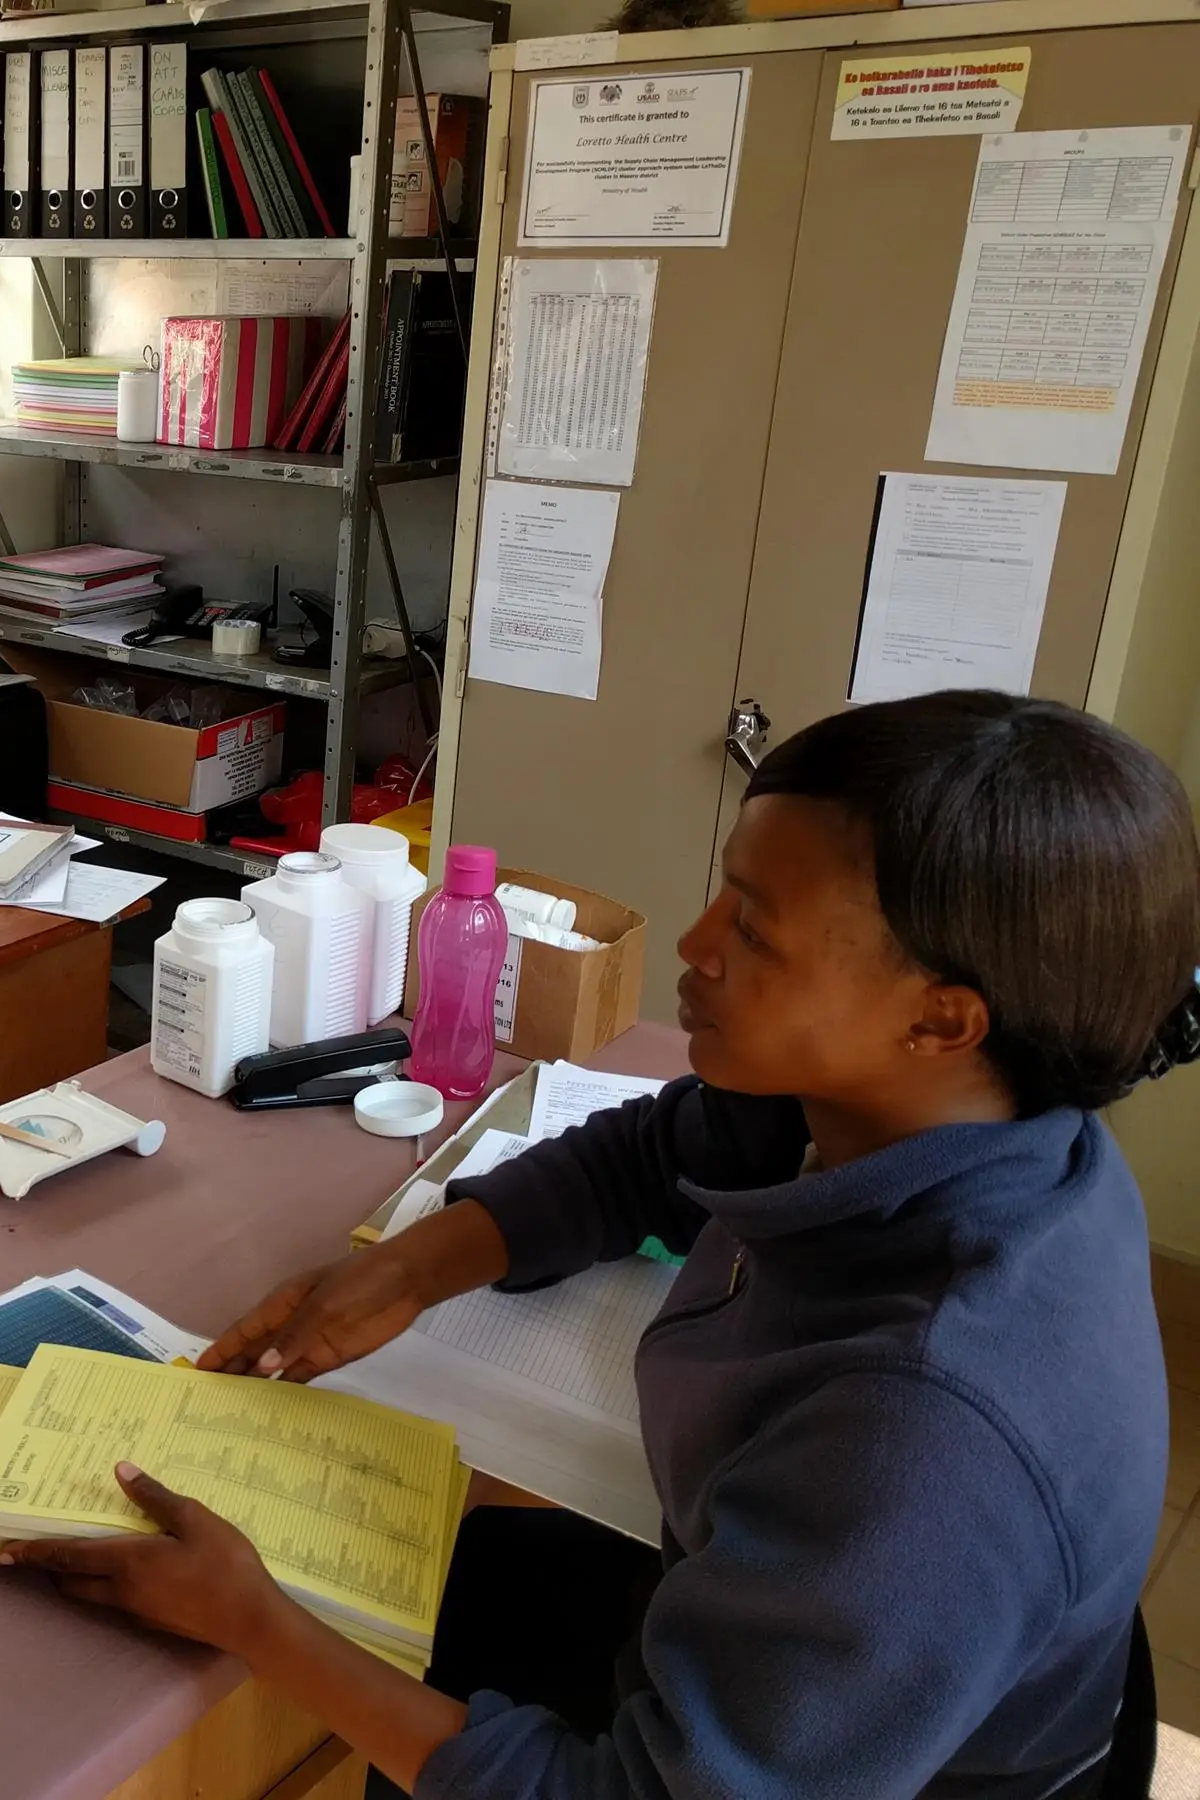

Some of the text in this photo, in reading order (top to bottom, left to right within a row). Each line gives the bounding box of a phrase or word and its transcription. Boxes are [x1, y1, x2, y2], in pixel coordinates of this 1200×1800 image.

[845, 73, 858, 84] Ke
[861, 87, 874, 97] ea
[876, 83, 908, 96] Basali
[931, 82, 954, 93] ama
[637, 93, 660, 103] USAID
[894, 103, 920, 114] Lilemo
[938, 101, 948, 111] 16
[579, 110, 689, 124] This certificate is granted to
[851, 118, 860, 127] 16
[975, 111, 1000, 121] Basali
[576, 133, 688, 147] Loretto Health Centre
[388, 318, 404, 412] APPOINTMENT BOOK
